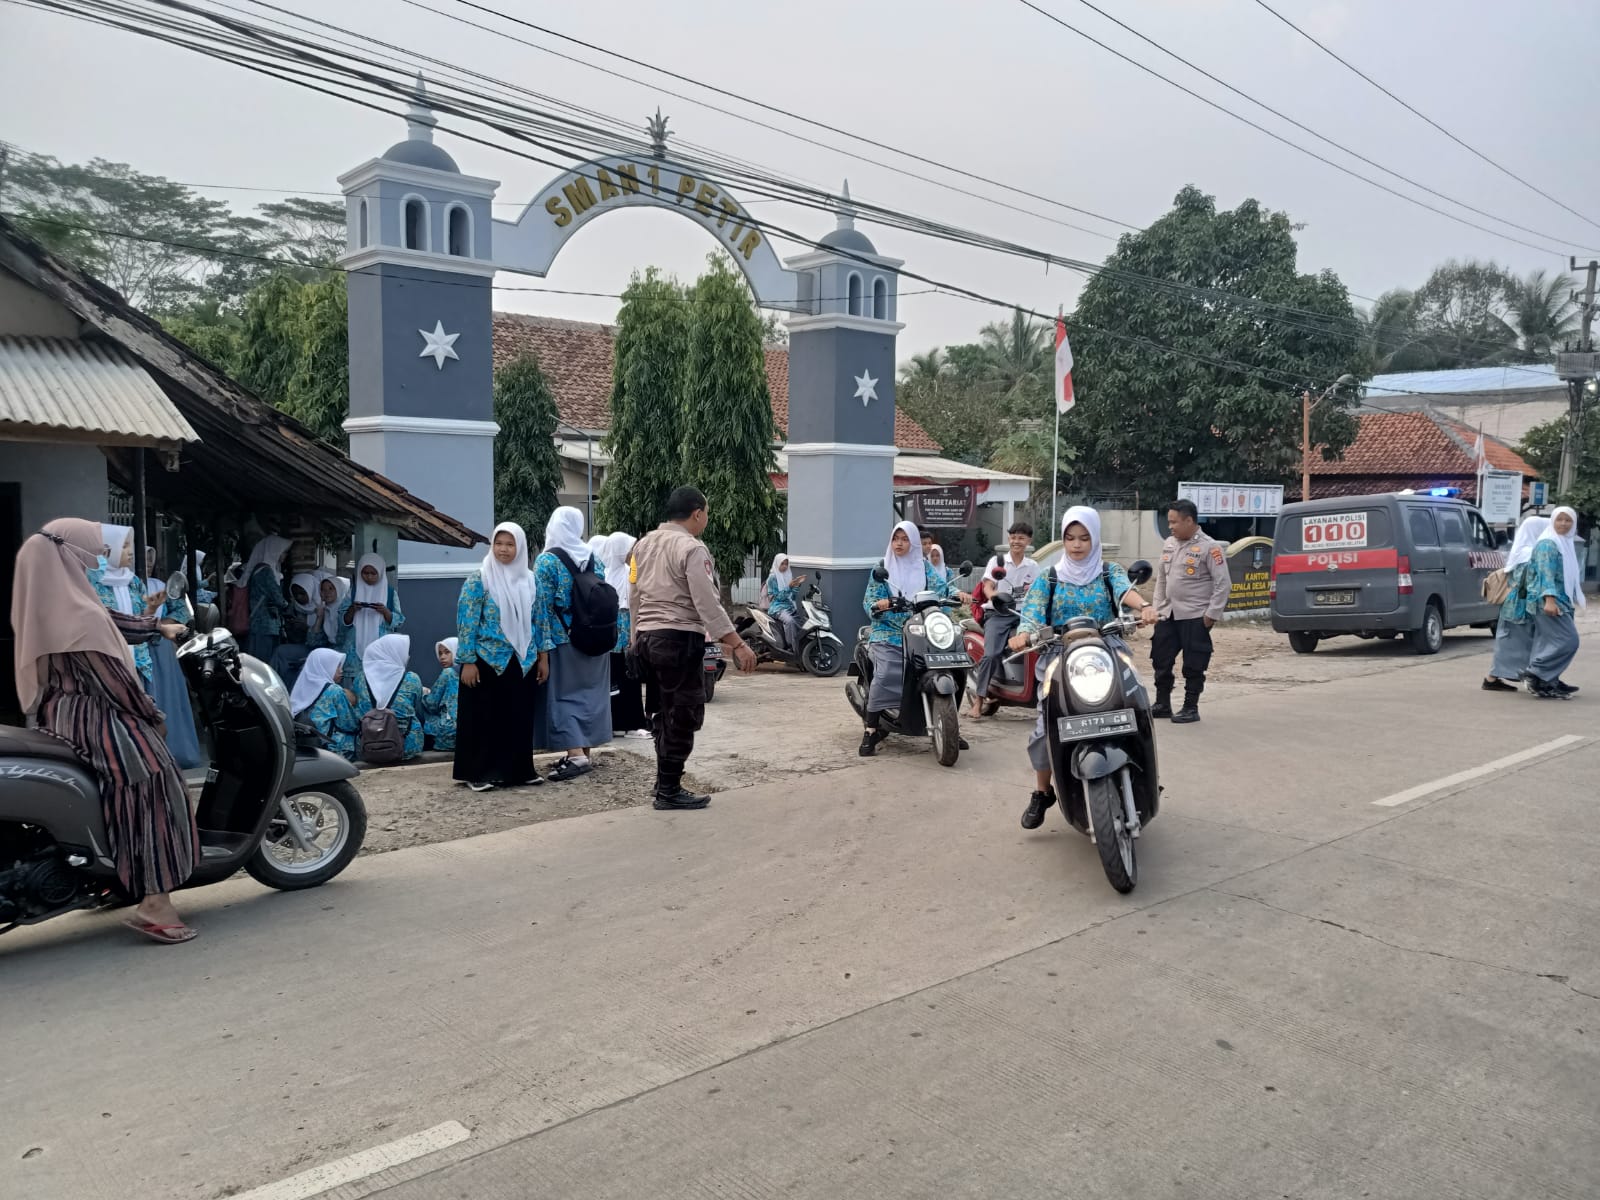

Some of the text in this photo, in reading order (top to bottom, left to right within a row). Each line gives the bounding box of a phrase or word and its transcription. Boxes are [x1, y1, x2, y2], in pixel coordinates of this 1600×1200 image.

[545, 163, 762, 261] SMAN 1 PETIR
[923, 498, 967, 506] SEKRETARIAT
[1303, 513, 1365, 526] LAYANAN POLISI
[1305, 523, 1364, 542] 110
[1308, 552, 1358, 566] POLISI
[1244, 572, 1269, 581] KANTOR
[1066, 721, 1073, 730] A
